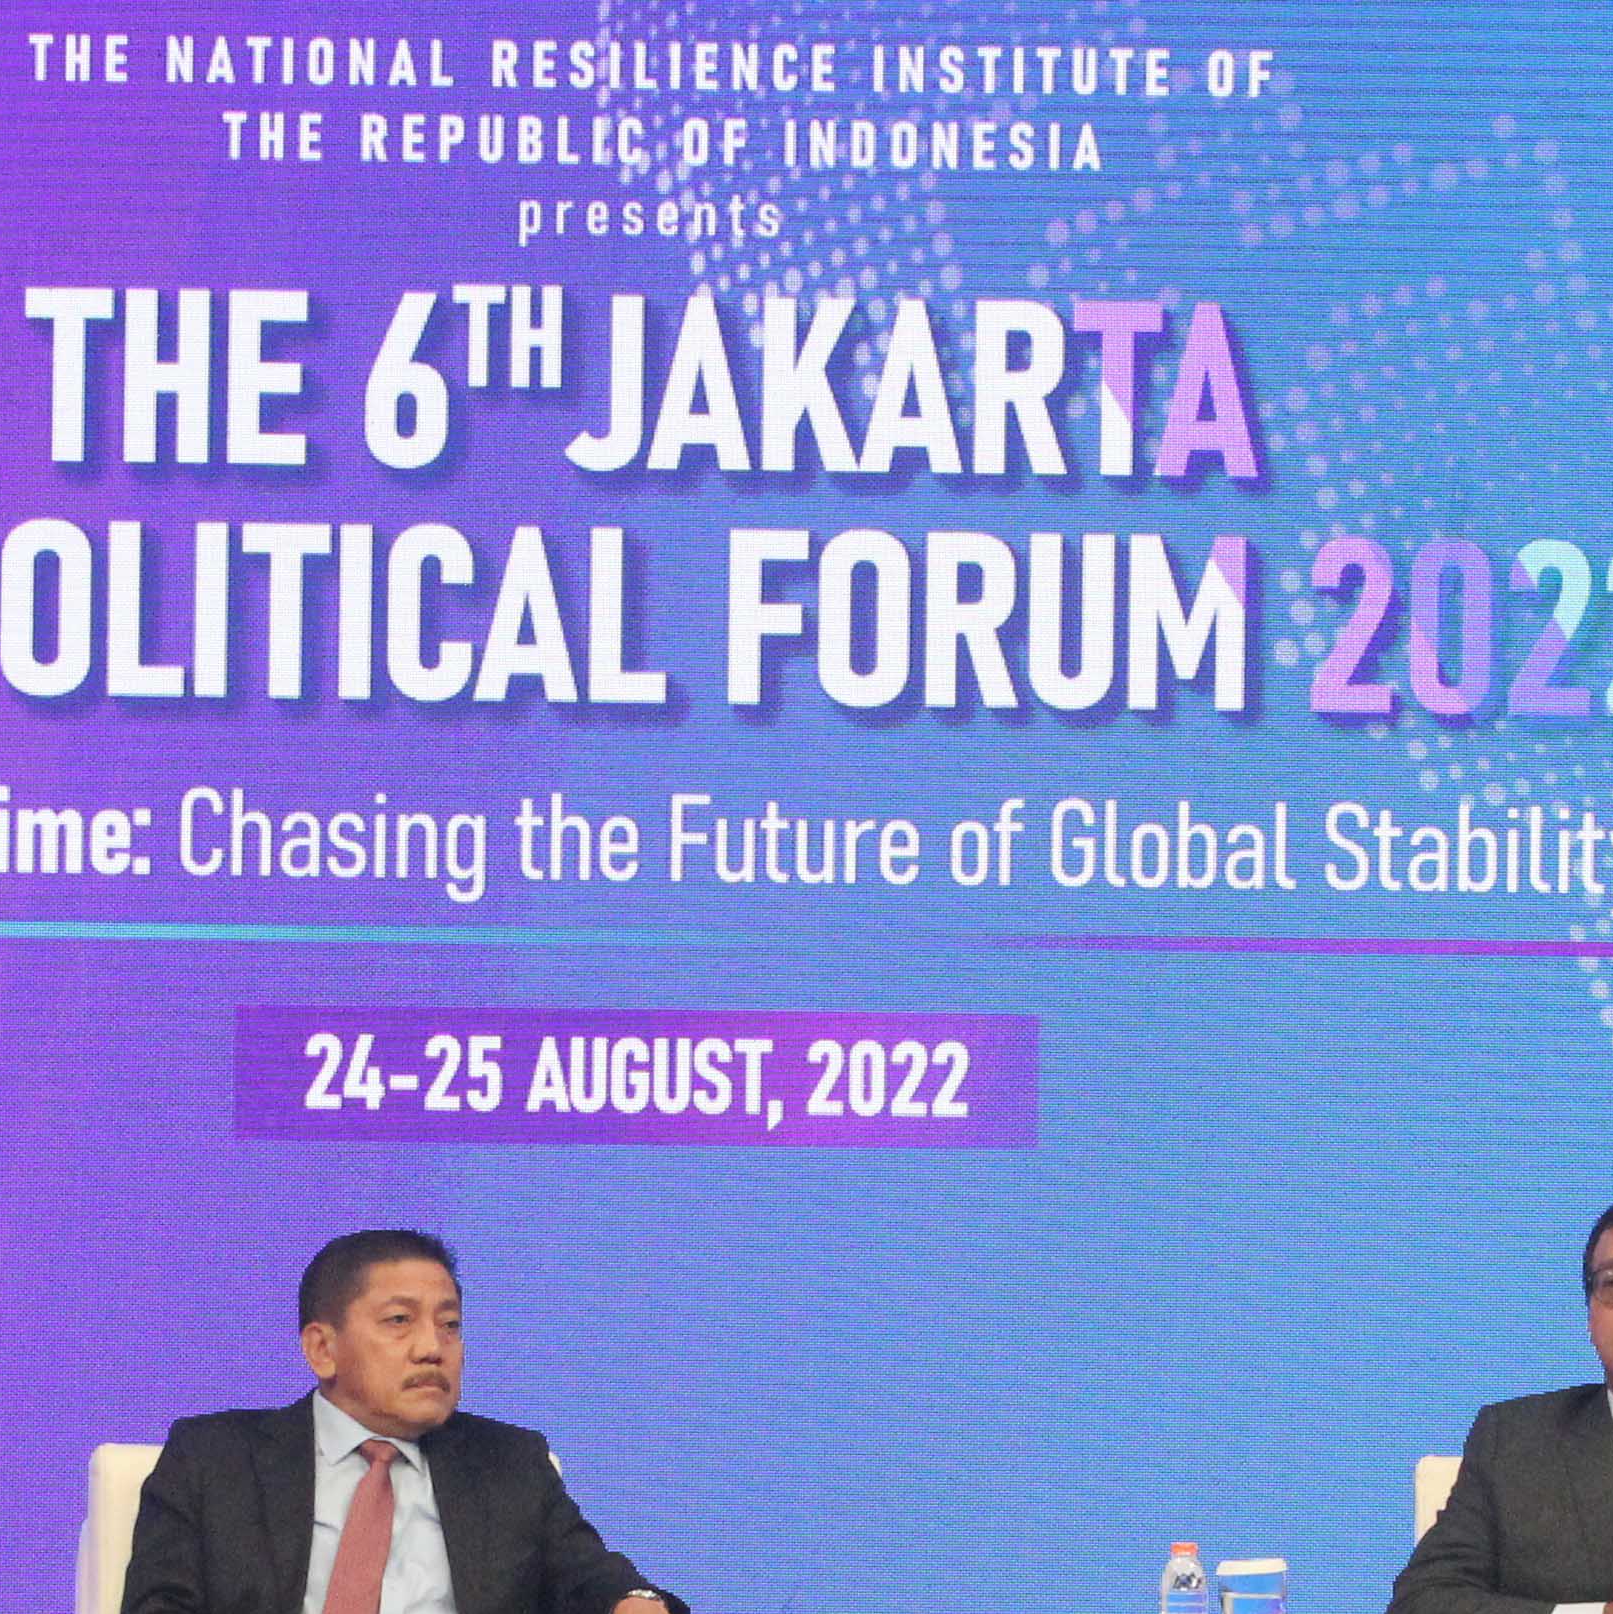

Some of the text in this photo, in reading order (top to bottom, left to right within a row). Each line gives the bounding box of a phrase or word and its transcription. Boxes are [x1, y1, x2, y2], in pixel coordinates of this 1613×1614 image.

[29, 34, 1274, 98] THE NATIONAL RESILIENCE INSTITUTE OF
[223, 112, 1103, 170] THE REPUBLIC OF INDONESIA
[518, 196, 782, 247] presents
[25, 287, 308, 465] THE
[564, 295, 1259, 478] JAKARTA
[728, 528, 1248, 712] FORUM
[178, 787, 487, 903] Chasing
[515, 793, 639, 882] the
[669, 794, 920, 884] Future
[949, 797, 1024, 886] of
[1050, 797, 1296, 891] Global
[303, 1033, 970, 1131] 24-25 AUGUST, 2022
